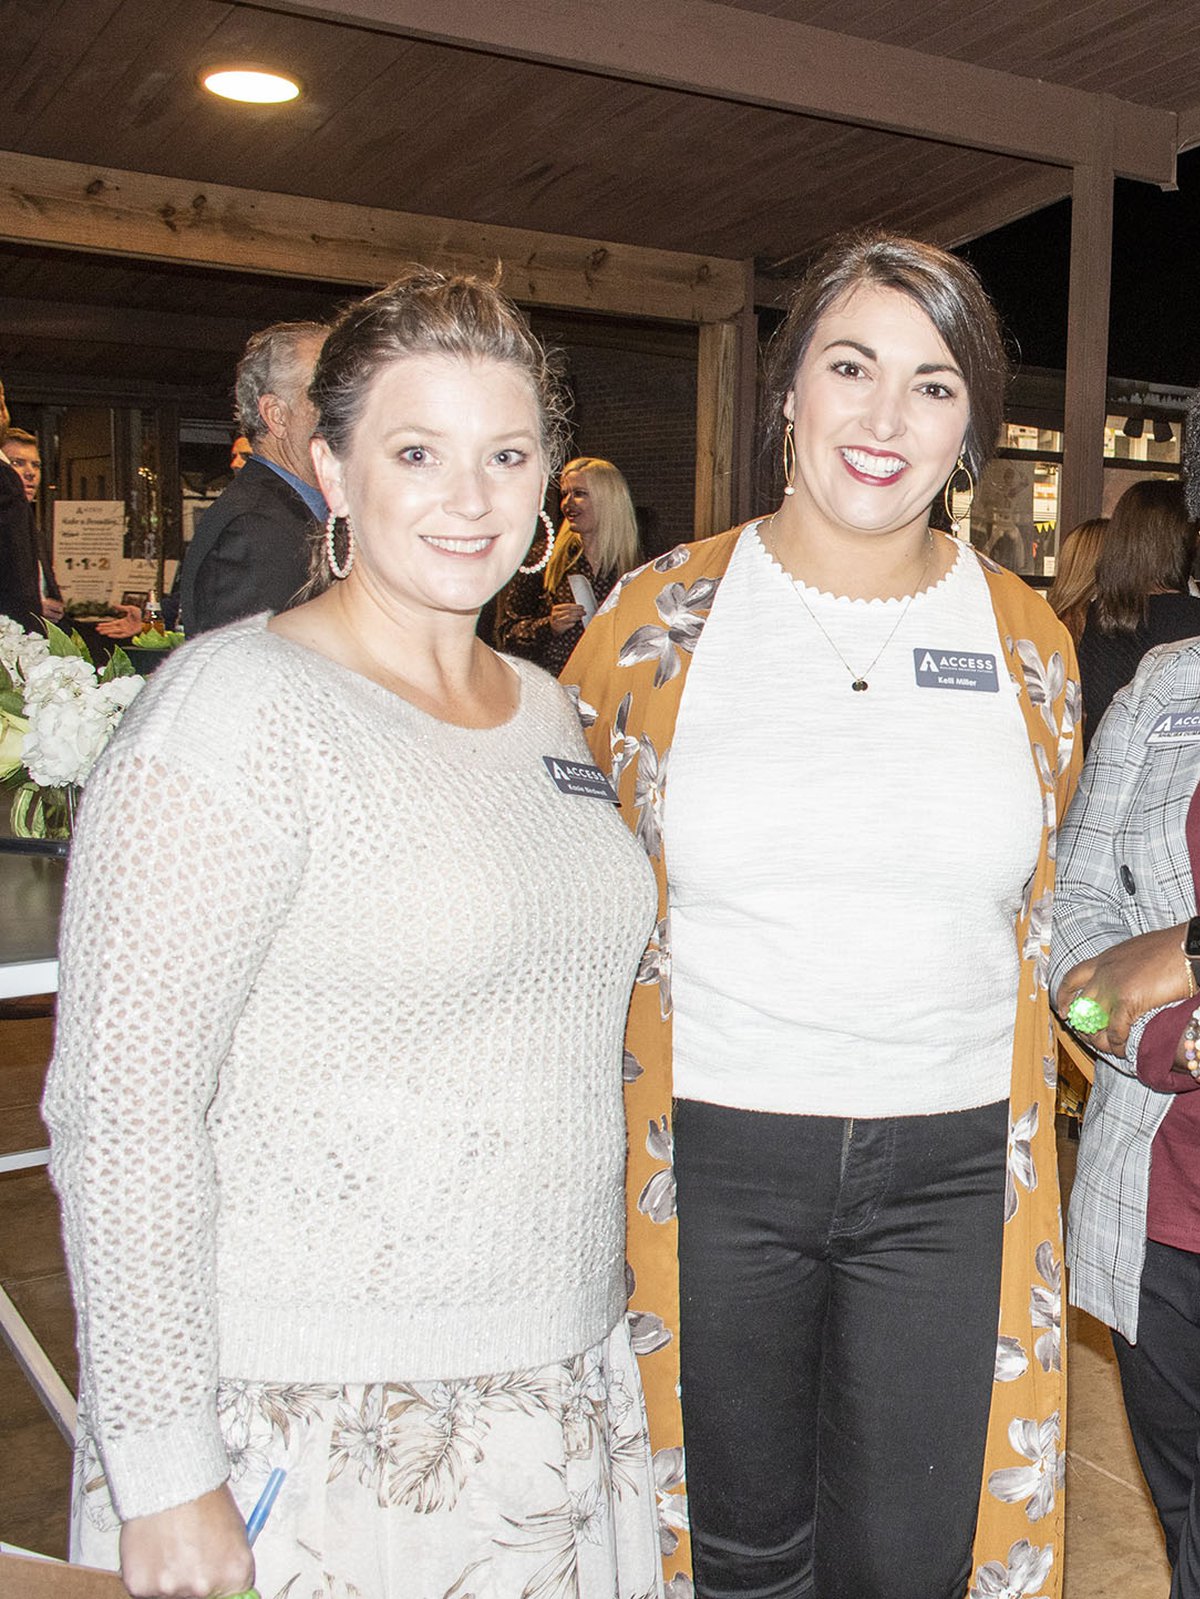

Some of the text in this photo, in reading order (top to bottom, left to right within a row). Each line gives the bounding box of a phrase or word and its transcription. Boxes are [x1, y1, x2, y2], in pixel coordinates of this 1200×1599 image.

[940, 656, 993, 670] ACCESS
[937, 676, 977, 687] Kelli Miller
[566, 766, 606, 782] ACCESS
